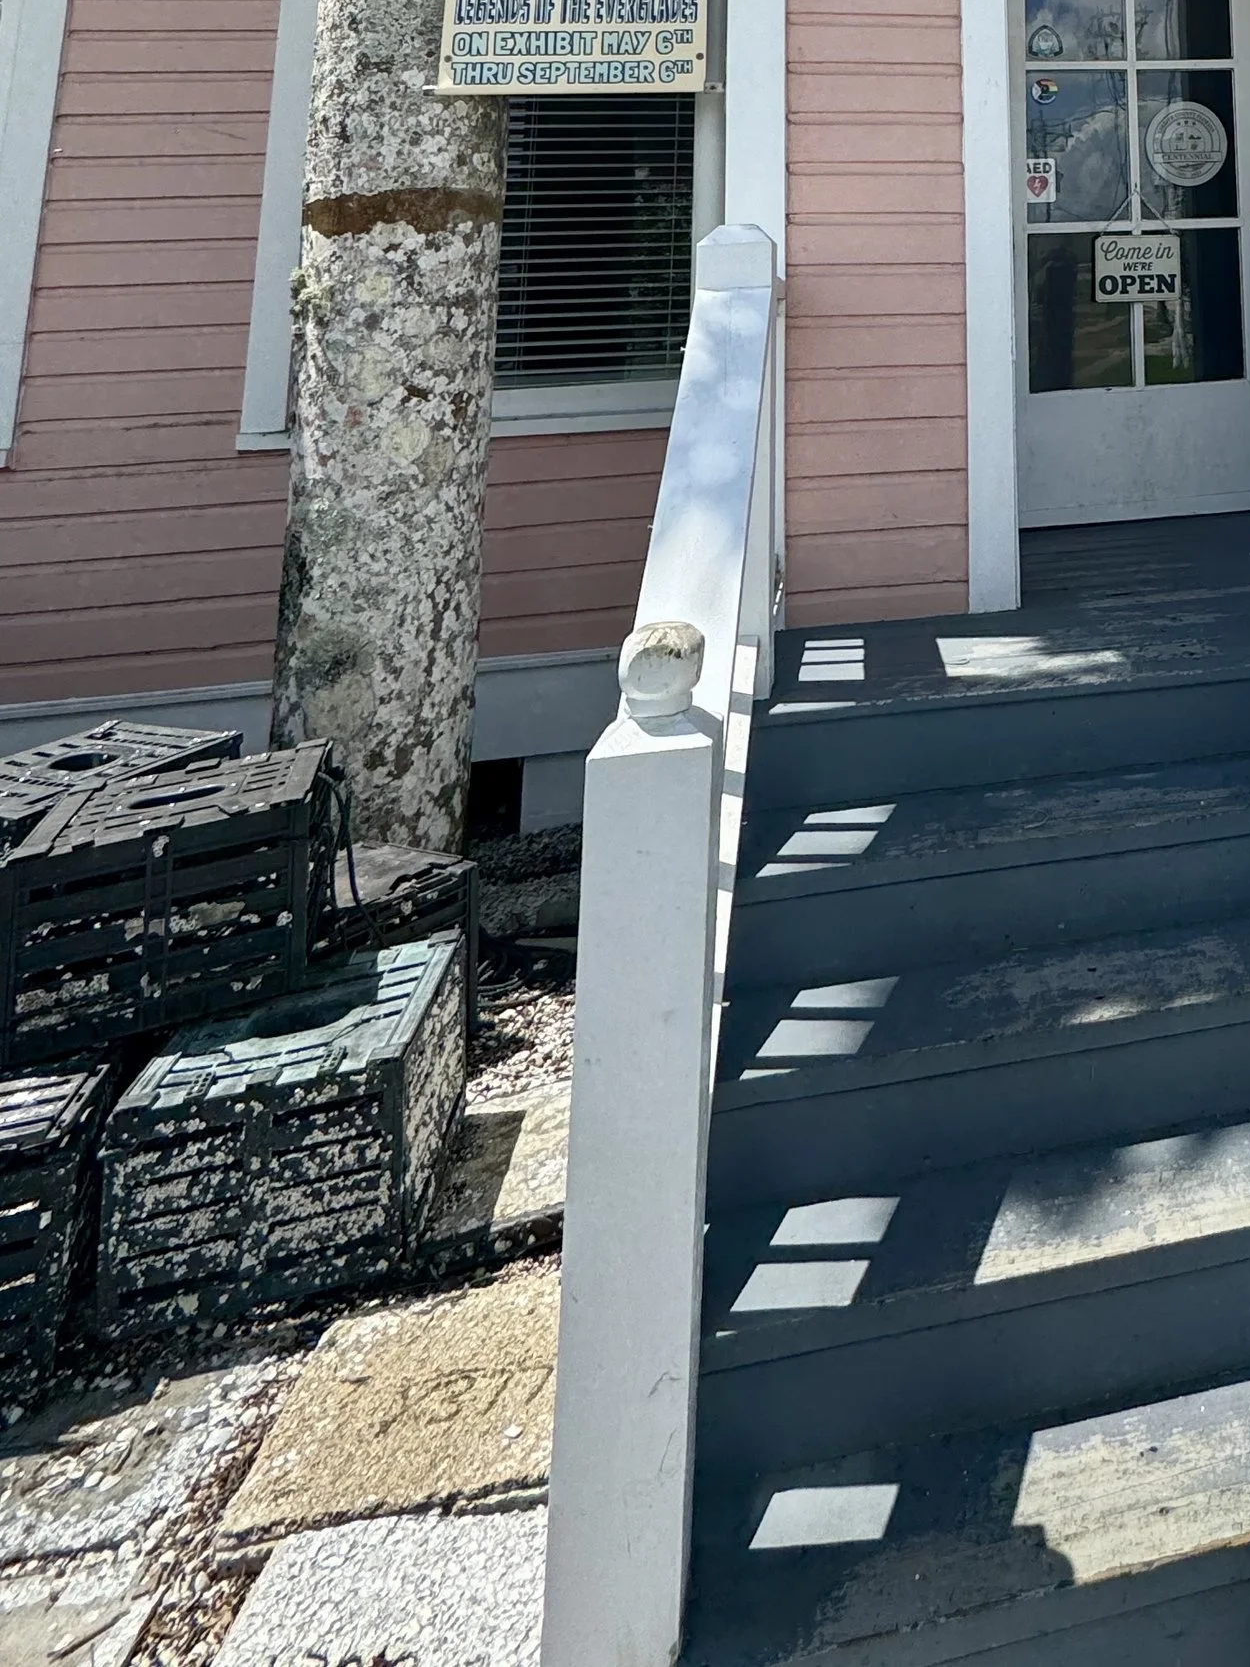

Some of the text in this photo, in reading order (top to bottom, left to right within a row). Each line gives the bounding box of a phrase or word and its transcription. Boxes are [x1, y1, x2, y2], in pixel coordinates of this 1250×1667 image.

[452, 31, 489, 56] ON
[493, 31, 597, 56] EXHIBIT
[601, 31, 651, 55] MAY
[451, 62, 514, 85] THRU
[517, 61, 655, 84] SEPTEMBER
[1101, 240, 1174, 261] Come in
[1123, 261, 1153, 272] WE'RE
[1099, 274, 1177, 295] OPEN
